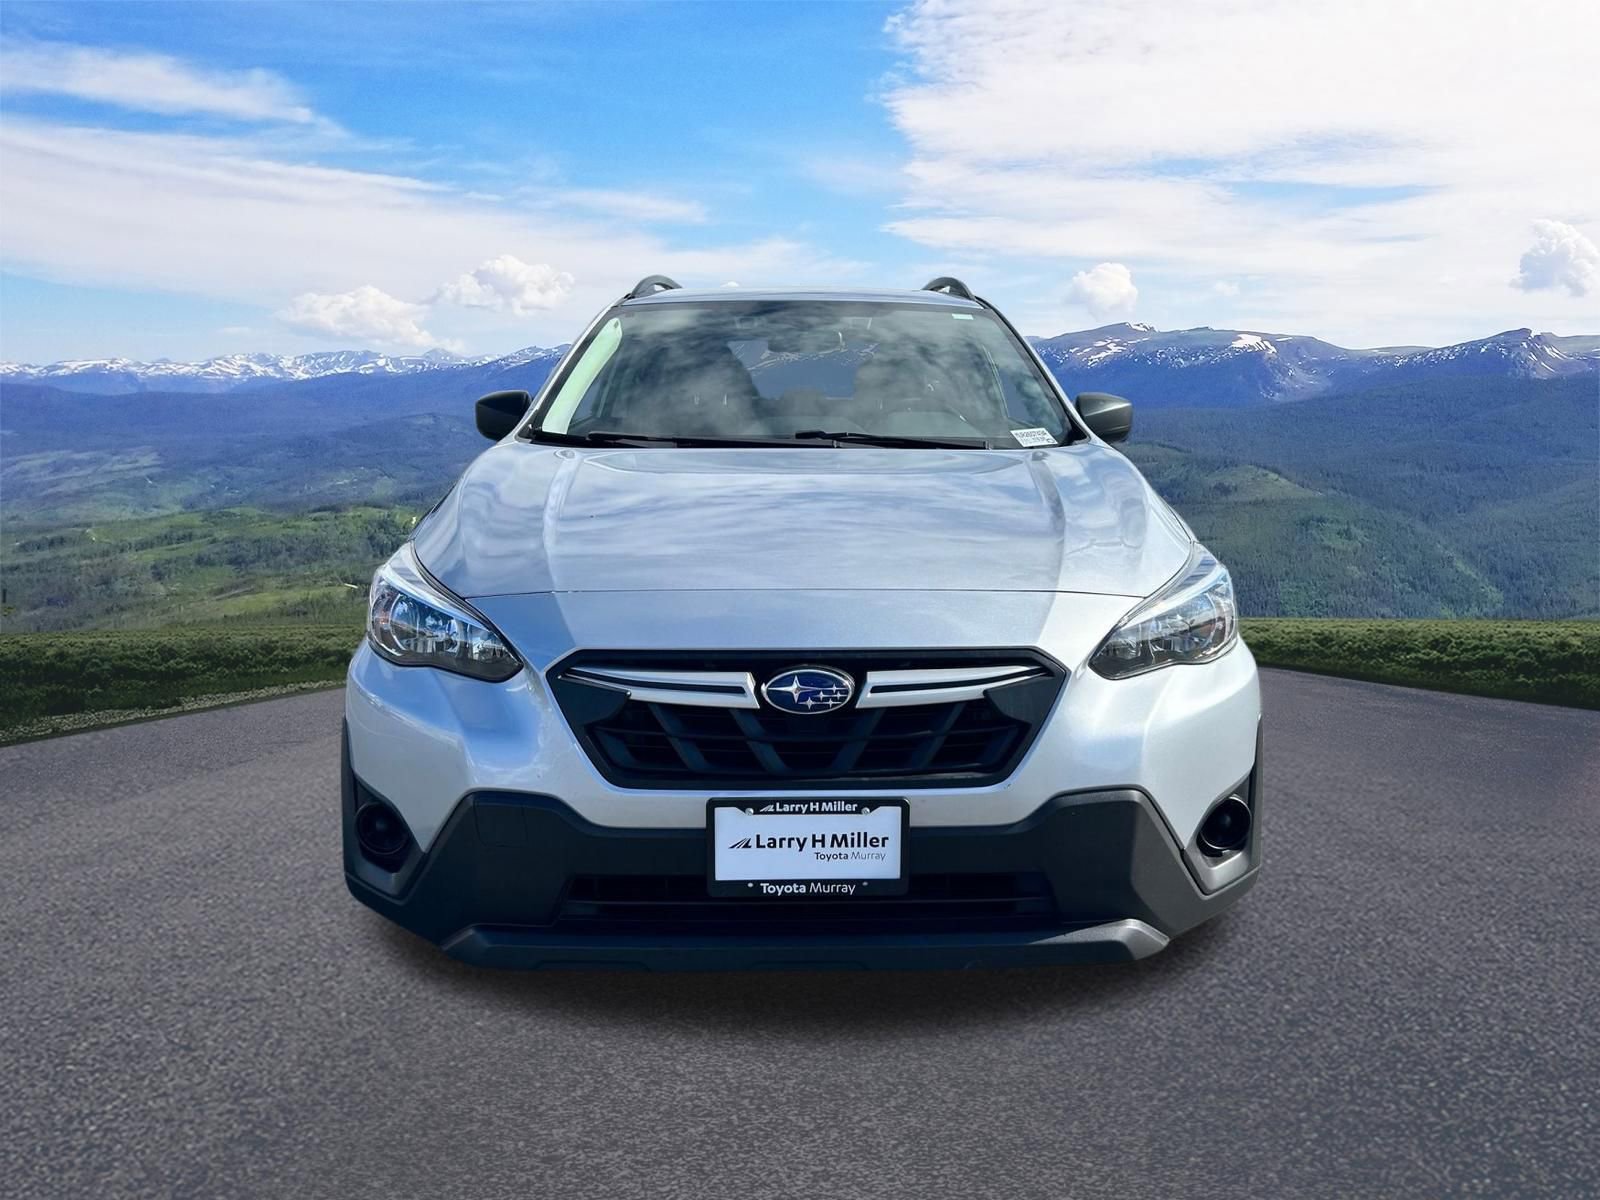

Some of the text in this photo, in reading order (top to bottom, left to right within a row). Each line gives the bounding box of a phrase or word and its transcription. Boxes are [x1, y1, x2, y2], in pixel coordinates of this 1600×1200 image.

[776, 801, 858, 814] Larry H Miller
[756, 831, 889, 852] Larry H Miller
[814, 851, 886, 862] Toyota Murray
[760, 882, 856, 896] Toyota Murray
